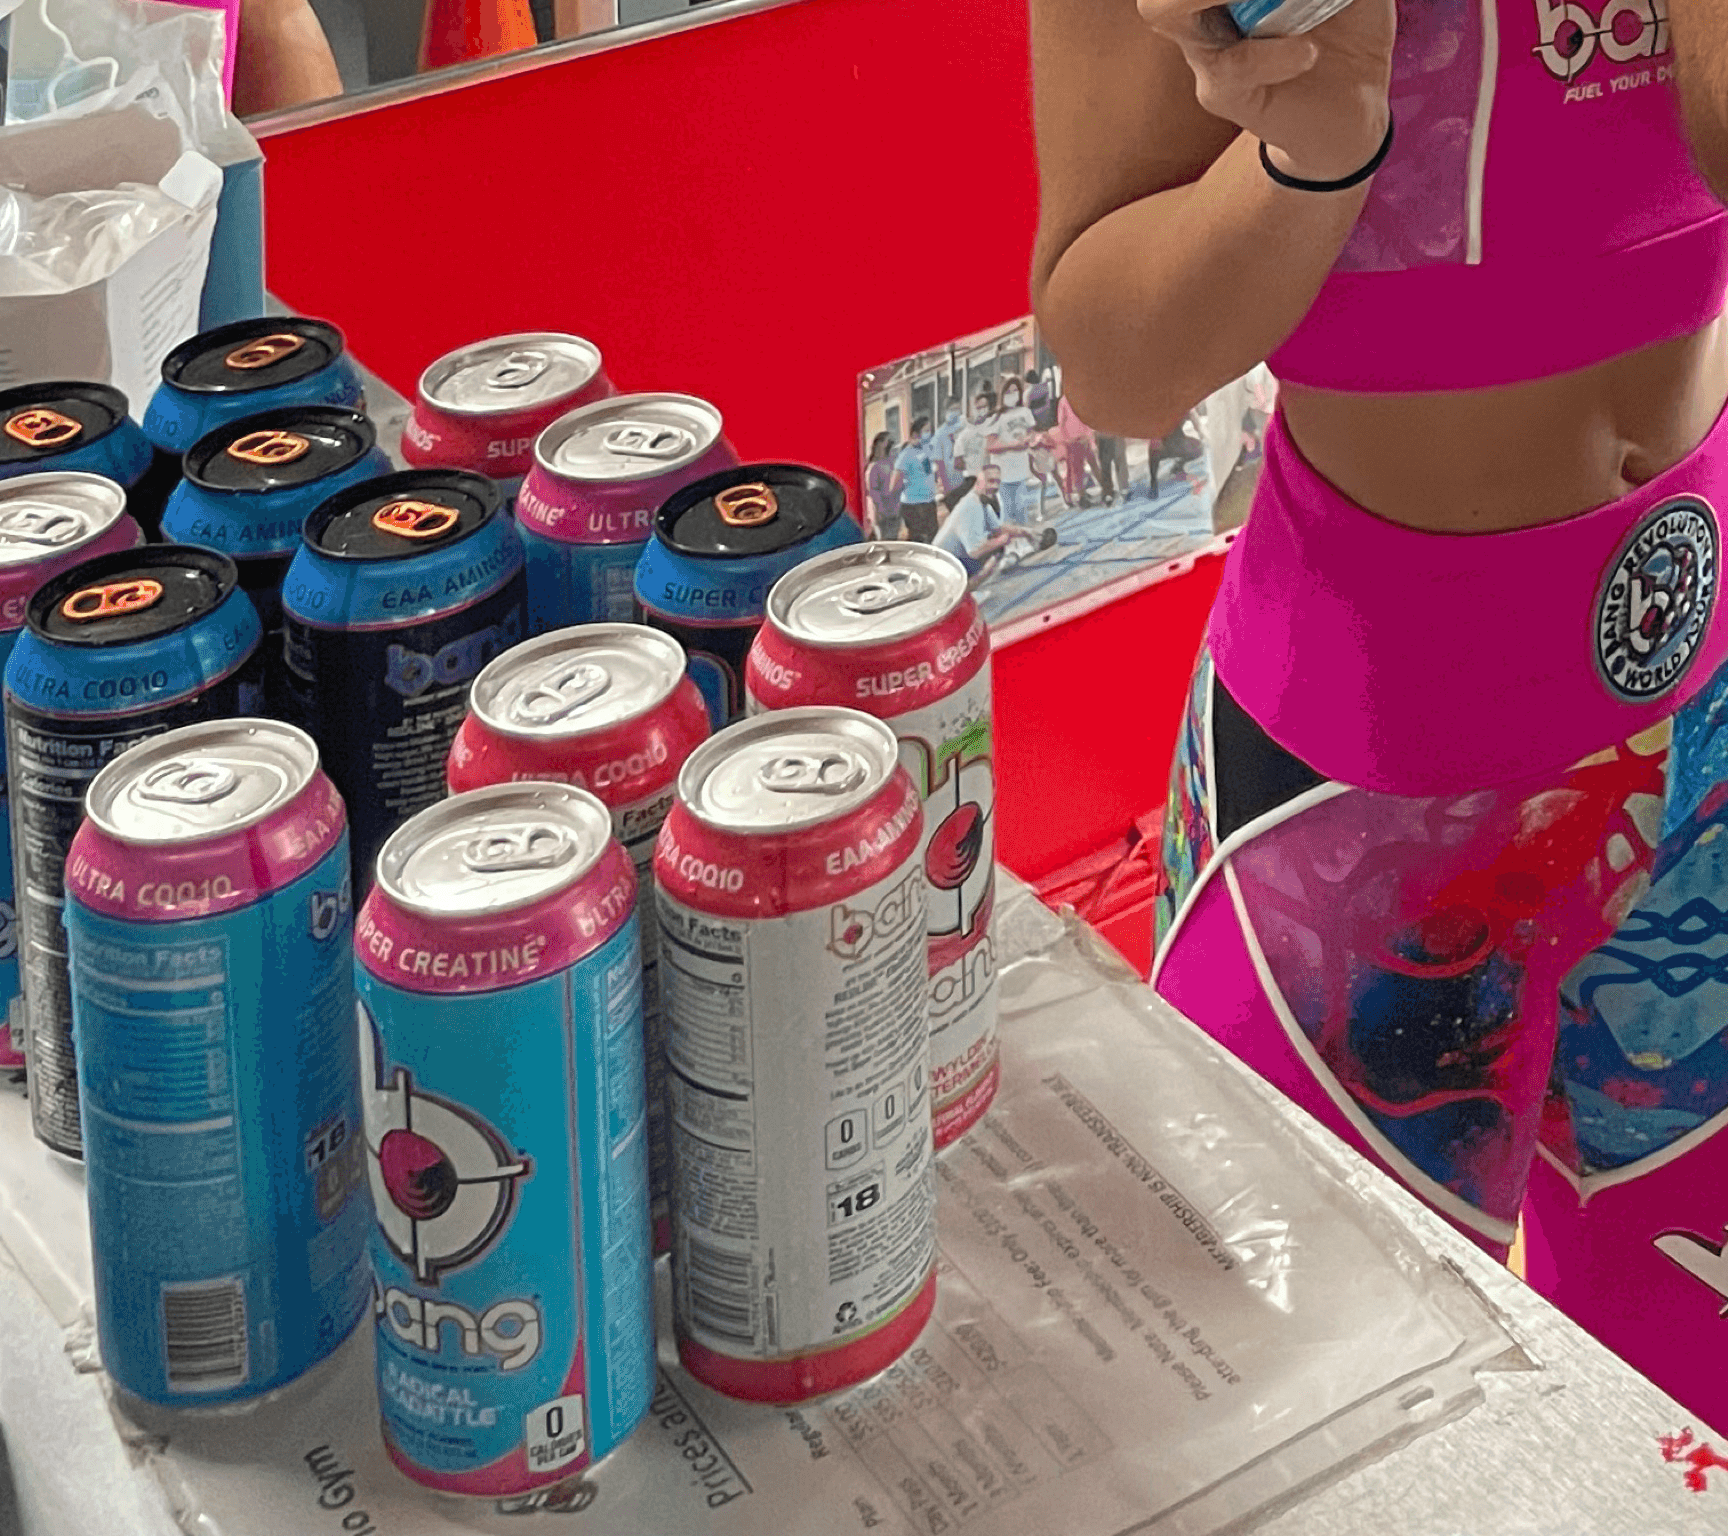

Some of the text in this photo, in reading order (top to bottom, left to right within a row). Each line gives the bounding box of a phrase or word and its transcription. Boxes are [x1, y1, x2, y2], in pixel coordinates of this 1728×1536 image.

[1563, 82, 1604, 105] FUEL
[1609, 69, 1651, 94] YOUR
[381, 584, 434, 610] EAA
[662, 580, 738, 609] SUPER
[13, 664, 71, 699] ULTRA
[854, 660, 936, 699] SUPER
[1624, 652, 1682, 689] WORLD
[824, 837, 874, 876] EAA
[71, 855, 126, 903] ULTRA
[137, 875, 233, 907] COQ10
[689, 916, 743, 942] Facts
[399, 935, 542, 977] CREATINE
[841, 1118, 854, 1144] 0
[836, 1183, 881, 1219] 18
[1144, 1174, 1167, 1197] IS
[1066, 1206, 1098, 1240] than
[1092, 1232, 1129, 1270] more
[1018, 1258, 1052, 1292] Fee:
[546, 1405, 564, 1439] 0
[296, 1439, 363, 1513] Gym
[661, 1426, 747, 1513] Prices
